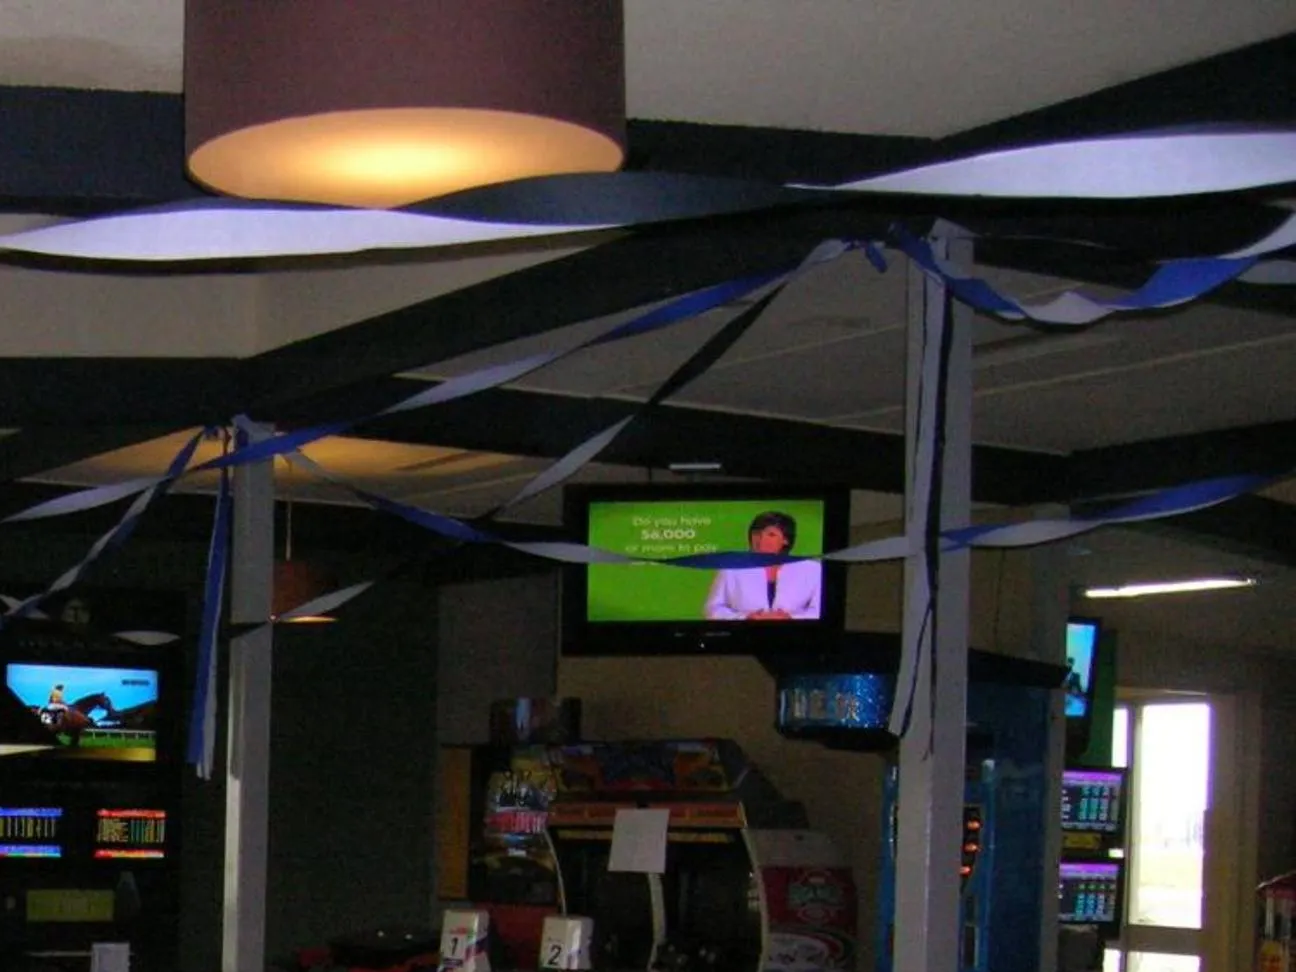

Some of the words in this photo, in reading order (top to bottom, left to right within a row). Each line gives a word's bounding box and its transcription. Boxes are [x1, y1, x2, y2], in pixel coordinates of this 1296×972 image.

[680, 515, 712, 527] have
[448, 937, 460, 956] 1
[548, 945, 563, 966] 2
